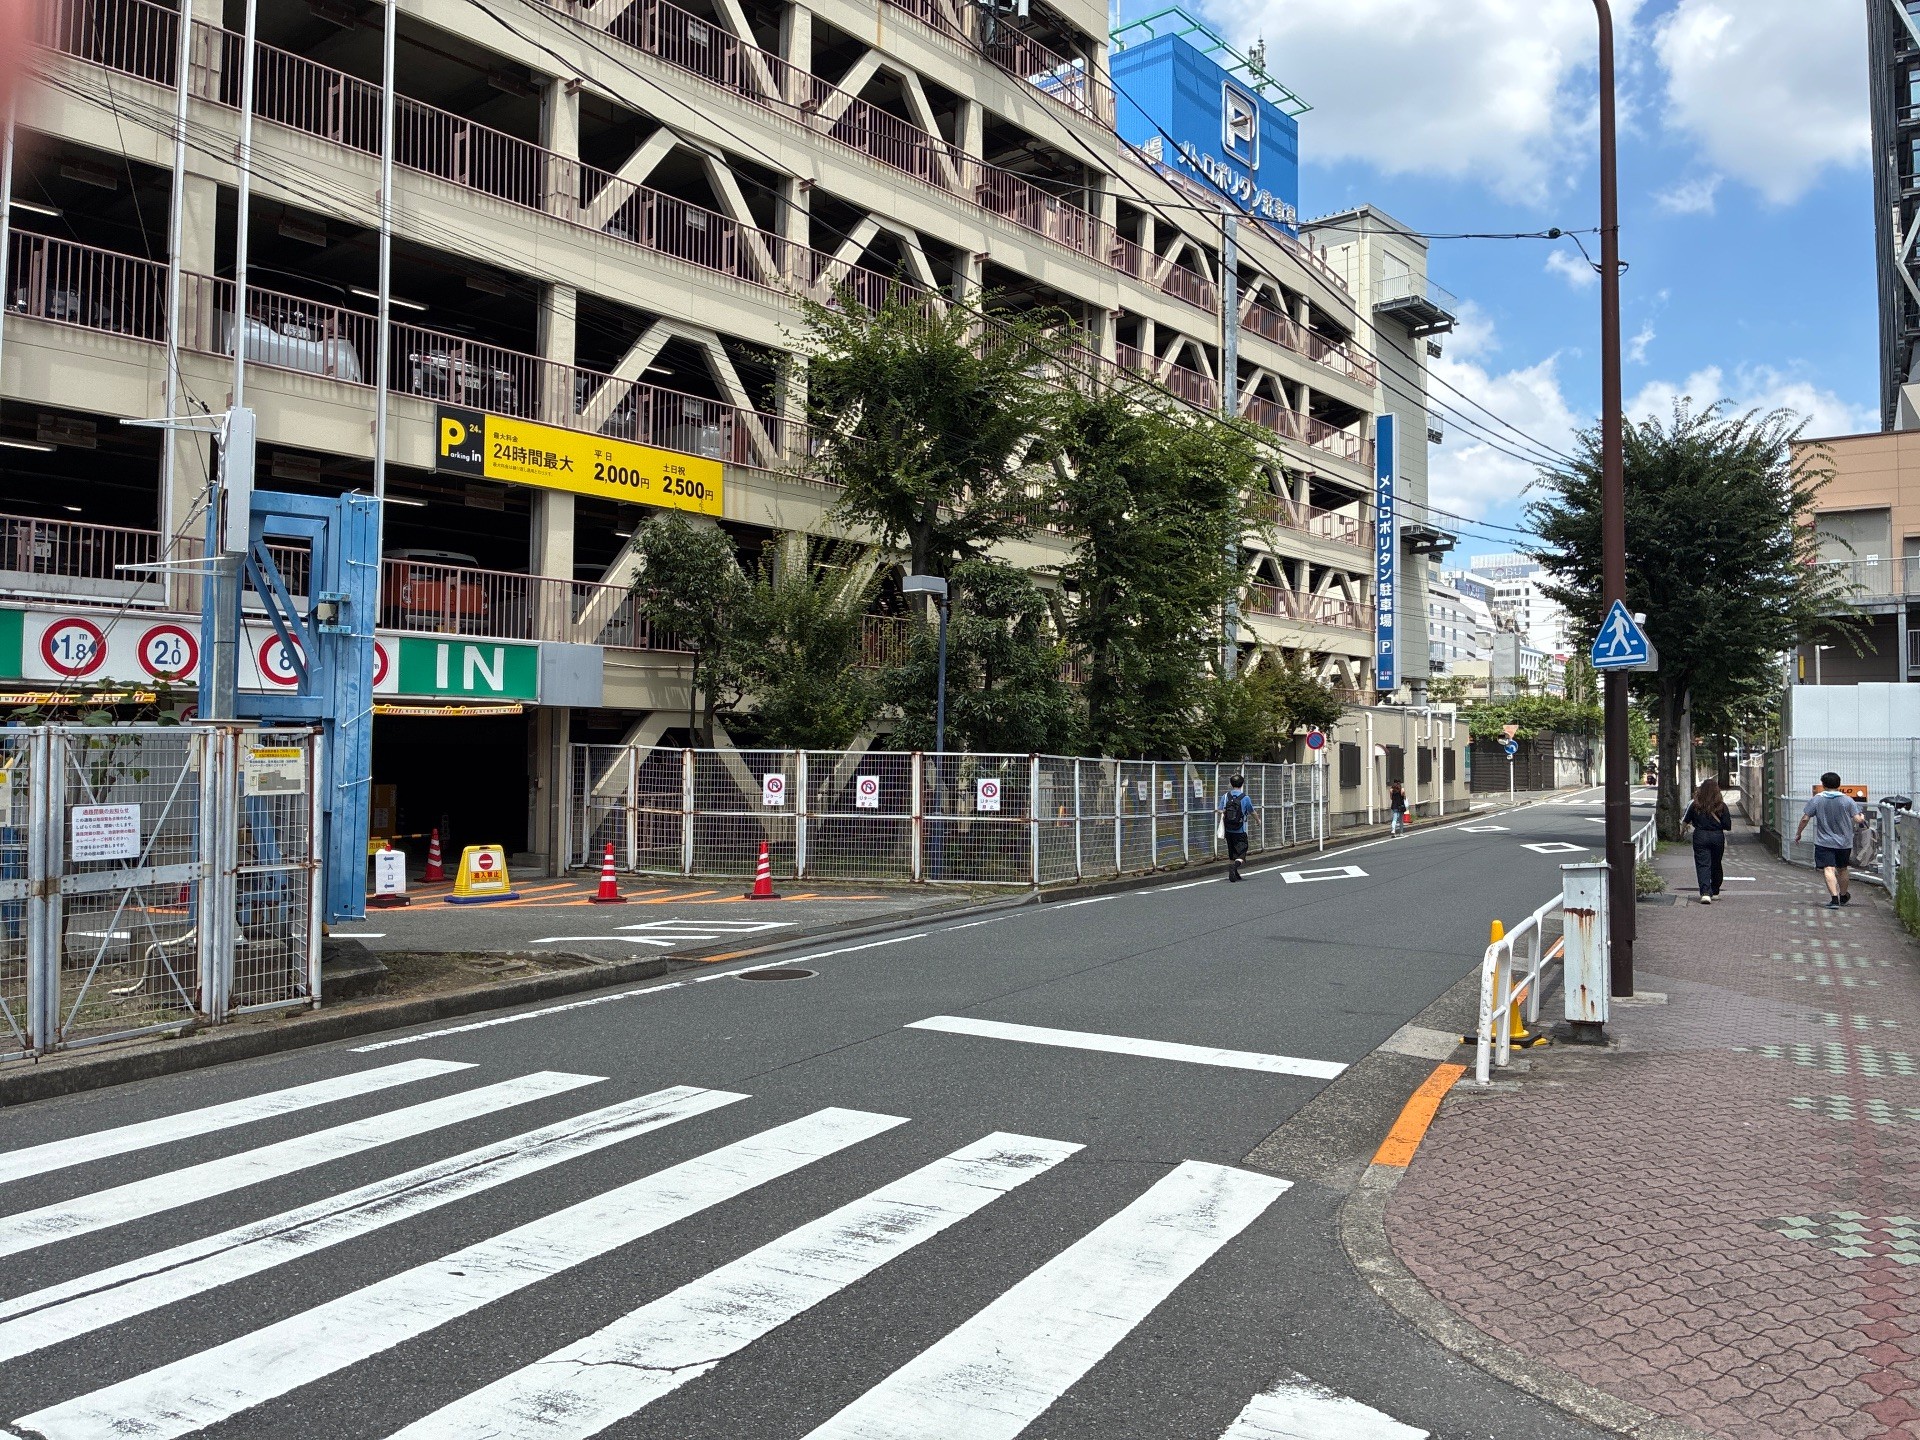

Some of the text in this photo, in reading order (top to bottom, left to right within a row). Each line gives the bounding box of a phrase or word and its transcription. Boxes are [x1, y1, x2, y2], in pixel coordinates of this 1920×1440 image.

[493, 432, 518, 443] 最大料金
[472, 449, 482, 462] in
[493, 443, 574, 473] 24時間最大
[594, 449, 612, 461] 平日
[594, 462, 650, 489] 2,000円
[663, 463, 686, 476] 土日祝
[663, 475, 714, 501] 2,500円
[1379, 474, 1393, 627] メトロポリタン駐車場
[60, 634, 87, 660] 1.8
[154, 640, 182, 665] 2.0
[436, 643, 504, 691] IN
